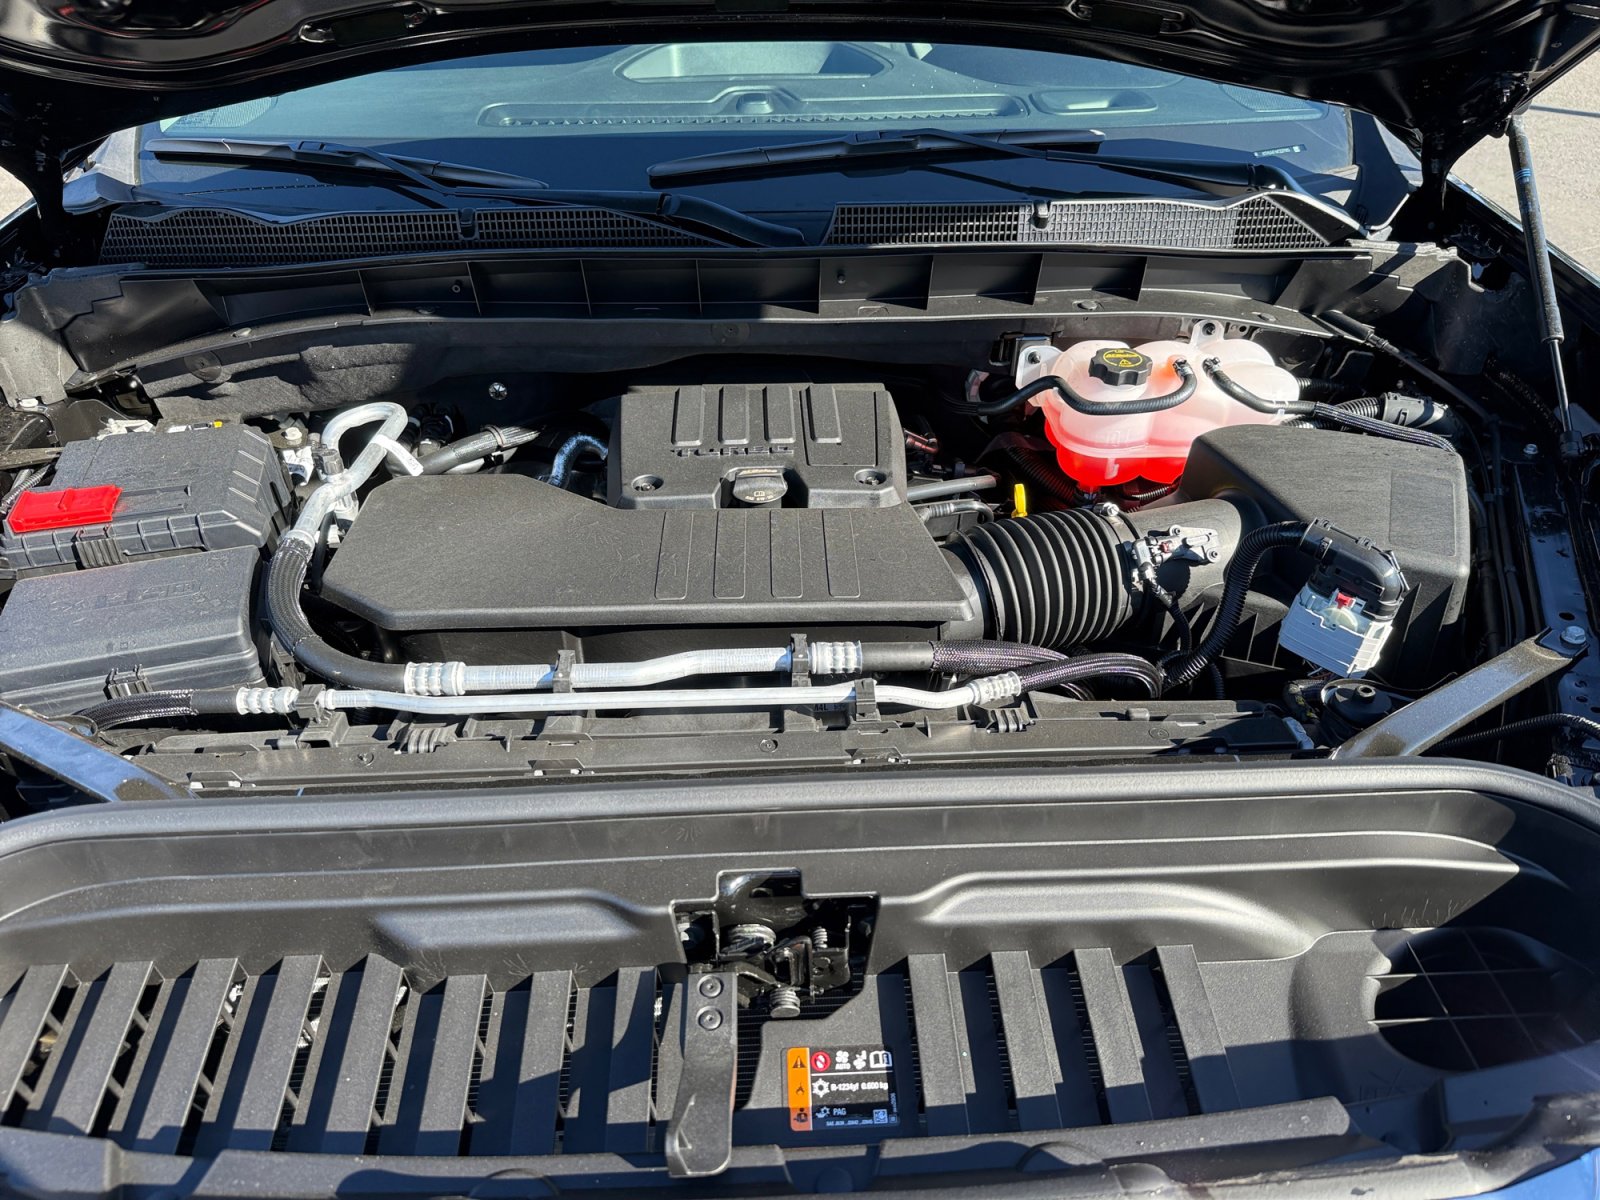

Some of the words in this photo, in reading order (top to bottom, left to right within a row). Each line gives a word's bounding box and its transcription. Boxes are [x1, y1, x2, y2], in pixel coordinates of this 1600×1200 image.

[670, 446, 794, 457] TURBO
[880, 1081, 889, 1091] kg
[833, 1107, 846, 1116] PAG
